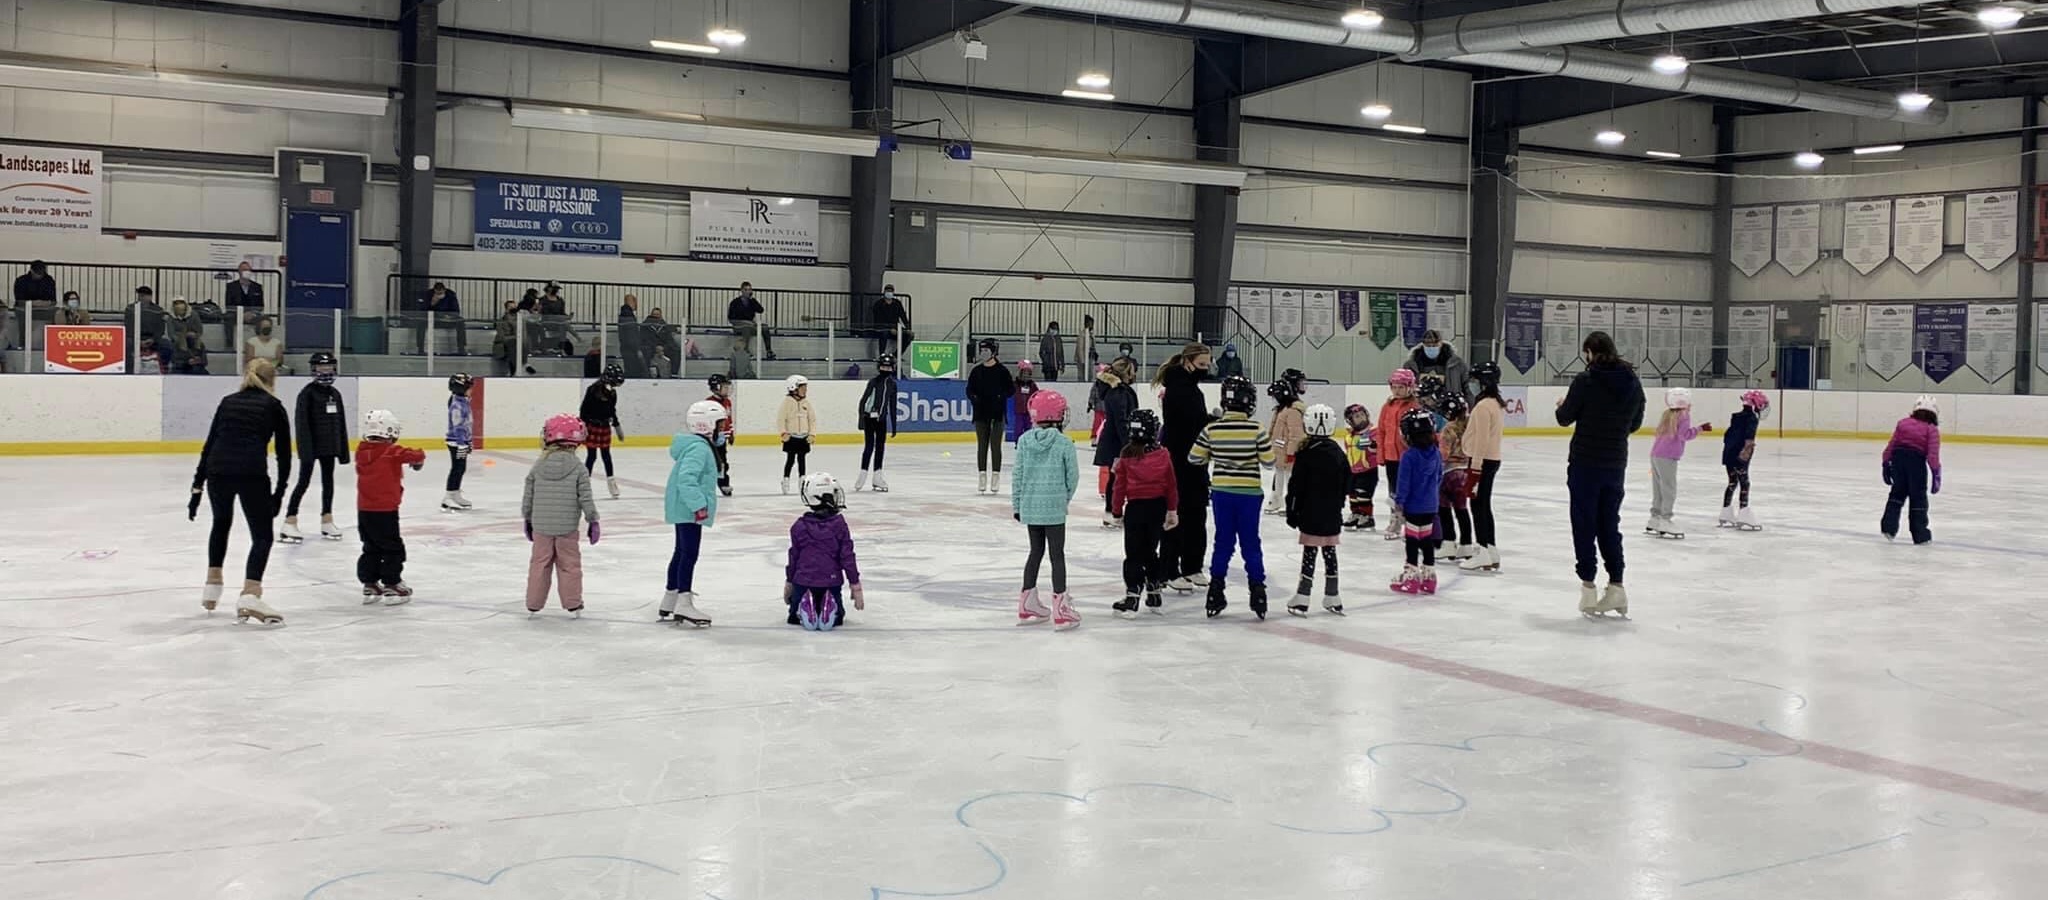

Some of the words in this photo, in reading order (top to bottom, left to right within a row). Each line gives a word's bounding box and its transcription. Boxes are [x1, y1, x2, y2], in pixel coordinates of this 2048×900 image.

[0, 153, 69, 177] Landscapes
[72, 158, 94, 175] Ltd.
[499, 182, 519, 197] IT'S
[521, 184, 541, 198] NOT
[543, 186, 567, 199] JUST
[569, 188, 578, 201] A
[578, 188, 600, 202] JOB.
[12, 206, 26, 214] for
[27, 208, 48, 216] over
[50, 207, 61, 216] 20
[63, 208, 93, 218] Years!
[504, 197, 524, 211] IT'S
[526, 198, 547, 213] OUR
[550, 200, 595, 215] PASSION.
[489, 218, 532, 230] SPECIALISTS
[476, 236, 545, 252] 403-238-8633
[57, 330, 113, 341] CONTROL
[896, 391, 974, 422] Shaw
